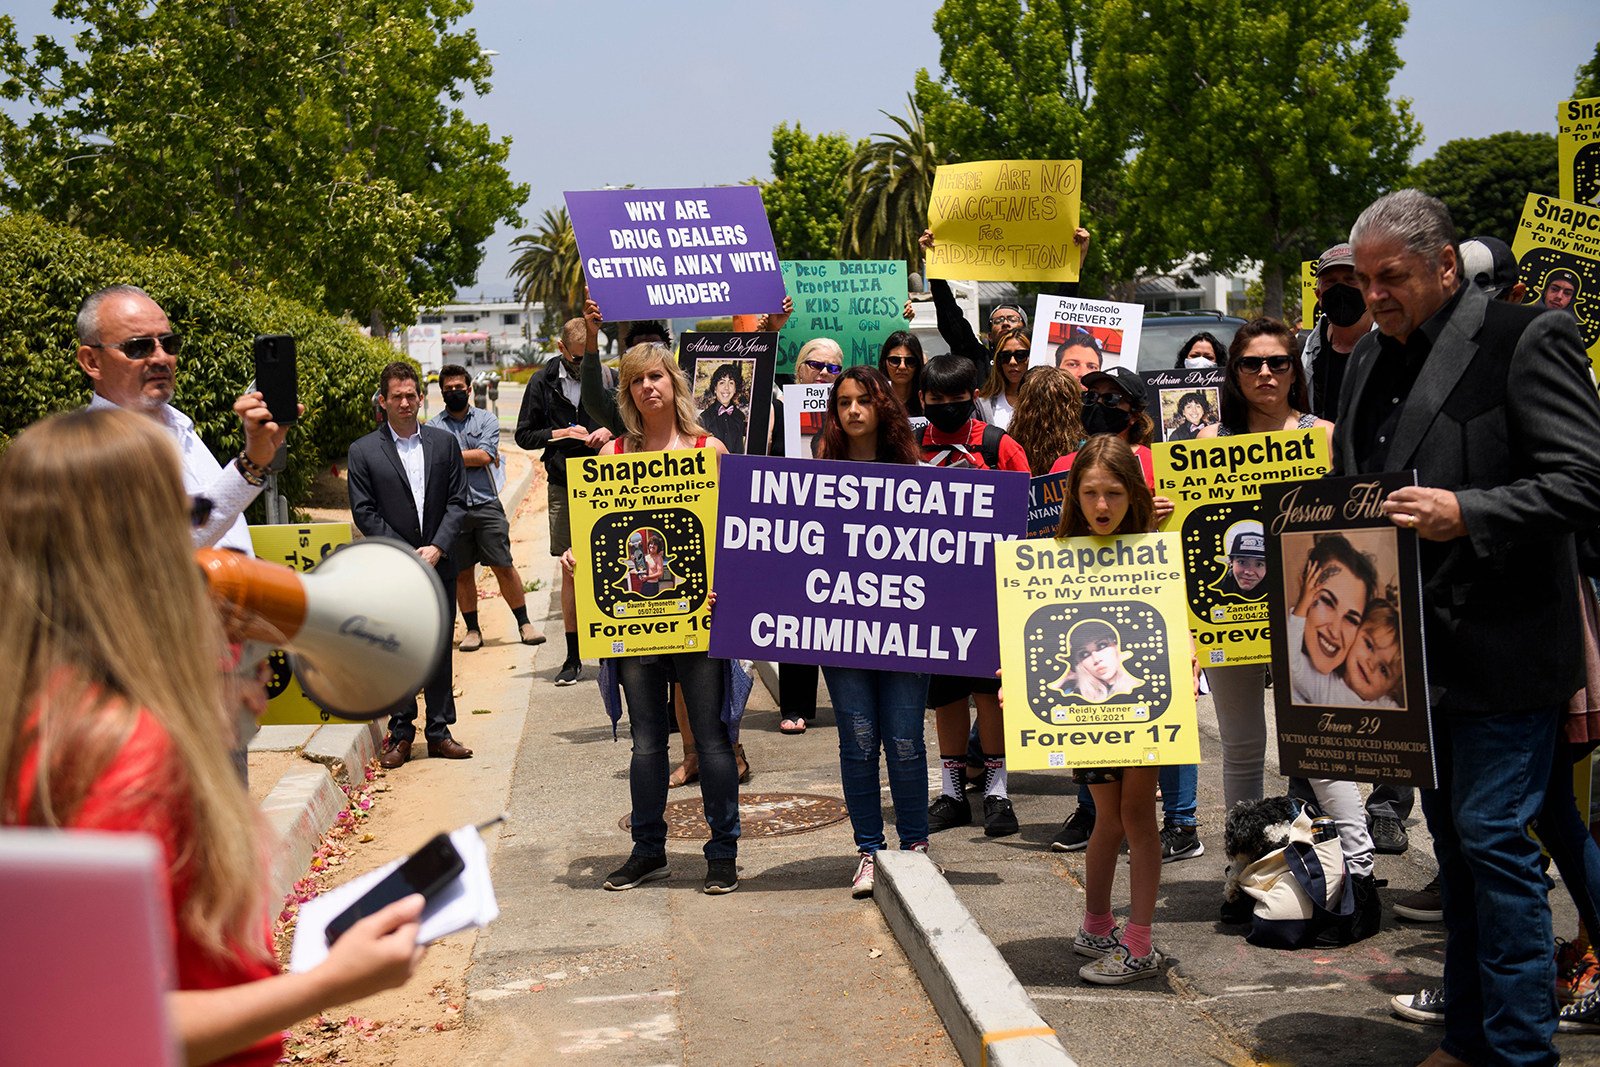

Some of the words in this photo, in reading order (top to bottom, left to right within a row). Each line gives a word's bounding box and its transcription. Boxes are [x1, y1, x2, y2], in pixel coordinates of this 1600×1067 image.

[1575, 123, 1592, 132] An
[1572, 134, 1588, 142] To
[938, 170, 982, 192] THERE
[995, 164, 1030, 192] ARE
[1041, 164, 1077, 196] NO
[624, 201, 666, 222] WHY
[675, 200, 710, 220] ARE
[934, 196, 1058, 222] VACCINES
[1534, 196, 1600, 232] Snapc
[1520, 218, 1532, 228] Is
[1536, 222, 1554, 234] An
[610, 228, 662, 250] DRUG
[666, 225, 748, 247] DEALERS
[1530, 232, 1546, 242] To
[1550, 236, 1570, 250] My
[588, 256, 667, 278] GETTING
[674, 254, 722, 276] AWAY
[728, 251, 776, 273] WITH
[931, 244, 1068, 270] ADDICTION
[795, 262, 827, 277] DRUG
[840, 262, 897, 275] DEALING
[646, 282, 730, 306] MURDER?
[796, 278, 882, 294] PEDOPHILIA
[806, 298, 840, 314] KIDS
[848, 297, 900, 318] ACCESS
[1059, 300, 1078, 312] Ray
[1080, 302, 1120, 314] Mascolo
[810, 317, 843, 331] ALL
[859, 320, 880, 331] ON
[1054, 312, 1106, 326] FOREVER
[1109, 317, 1122, 326] 37
[686, 337, 720, 352] Adrian
[1147, 372, 1181, 386] Adrian
[806, 388, 824, 398] Ray
[1170, 432, 1315, 473] Snapchat
[582, 450, 706, 484] Snapchat
[1159, 478, 1176, 490] Is
[1182, 476, 1207, 488] An
[1214, 464, 1327, 484] Accomplice
[573, 488, 586, 498] Is
[592, 487, 614, 497] An
[619, 480, 716, 495] Accomplice
[750, 470, 995, 518] INVESTIGATE
[1179, 490, 1202, 501] To
[1208, 487, 1234, 500] My
[589, 500, 608, 510] To
[614, 497, 637, 508] My
[642, 492, 700, 506] Murder
[1270, 485, 1336, 536] Jessica
[723, 516, 825, 556] DRUG
[843, 523, 1018, 566] TOXICIT
[1016, 539, 1168, 574] Snapchat
[1004, 578, 1020, 588] Is
[1028, 576, 1053, 586] An
[1061, 570, 1181, 584] Accomplice
[806, 568, 926, 610] CASES
[1024, 590, 1047, 600] To
[1054, 588, 1082, 600] My
[1090, 584, 1162, 598] Murder
[1226, 605, 1258, 613] Zander
[589, 618, 679, 638] Forever
[750, 612, 978, 661] CRIMINALLY
[1069, 706, 1098, 714] Reidly
[1356, 716, 1381, 734] 29
[1020, 729, 1136, 747] Forever
[1146, 724, 1182, 743] 17
[1280, 733, 1308, 744] VICTIM
[1308, 736, 1318, 745] OF
[1320, 736, 1343, 747] DRUG
[1344, 738, 1382, 749] INDUCED
[1384, 740, 1428, 752] HOMICIDE
[1066, 758, 1142, 766] druginducedhomicide.org
[1298, 760, 1318, 770] March
[1306, 748, 1344, 760] POISONED
[1346, 751, 1356, 760] BY
[1358, 752, 1400, 764] FENTANYL
